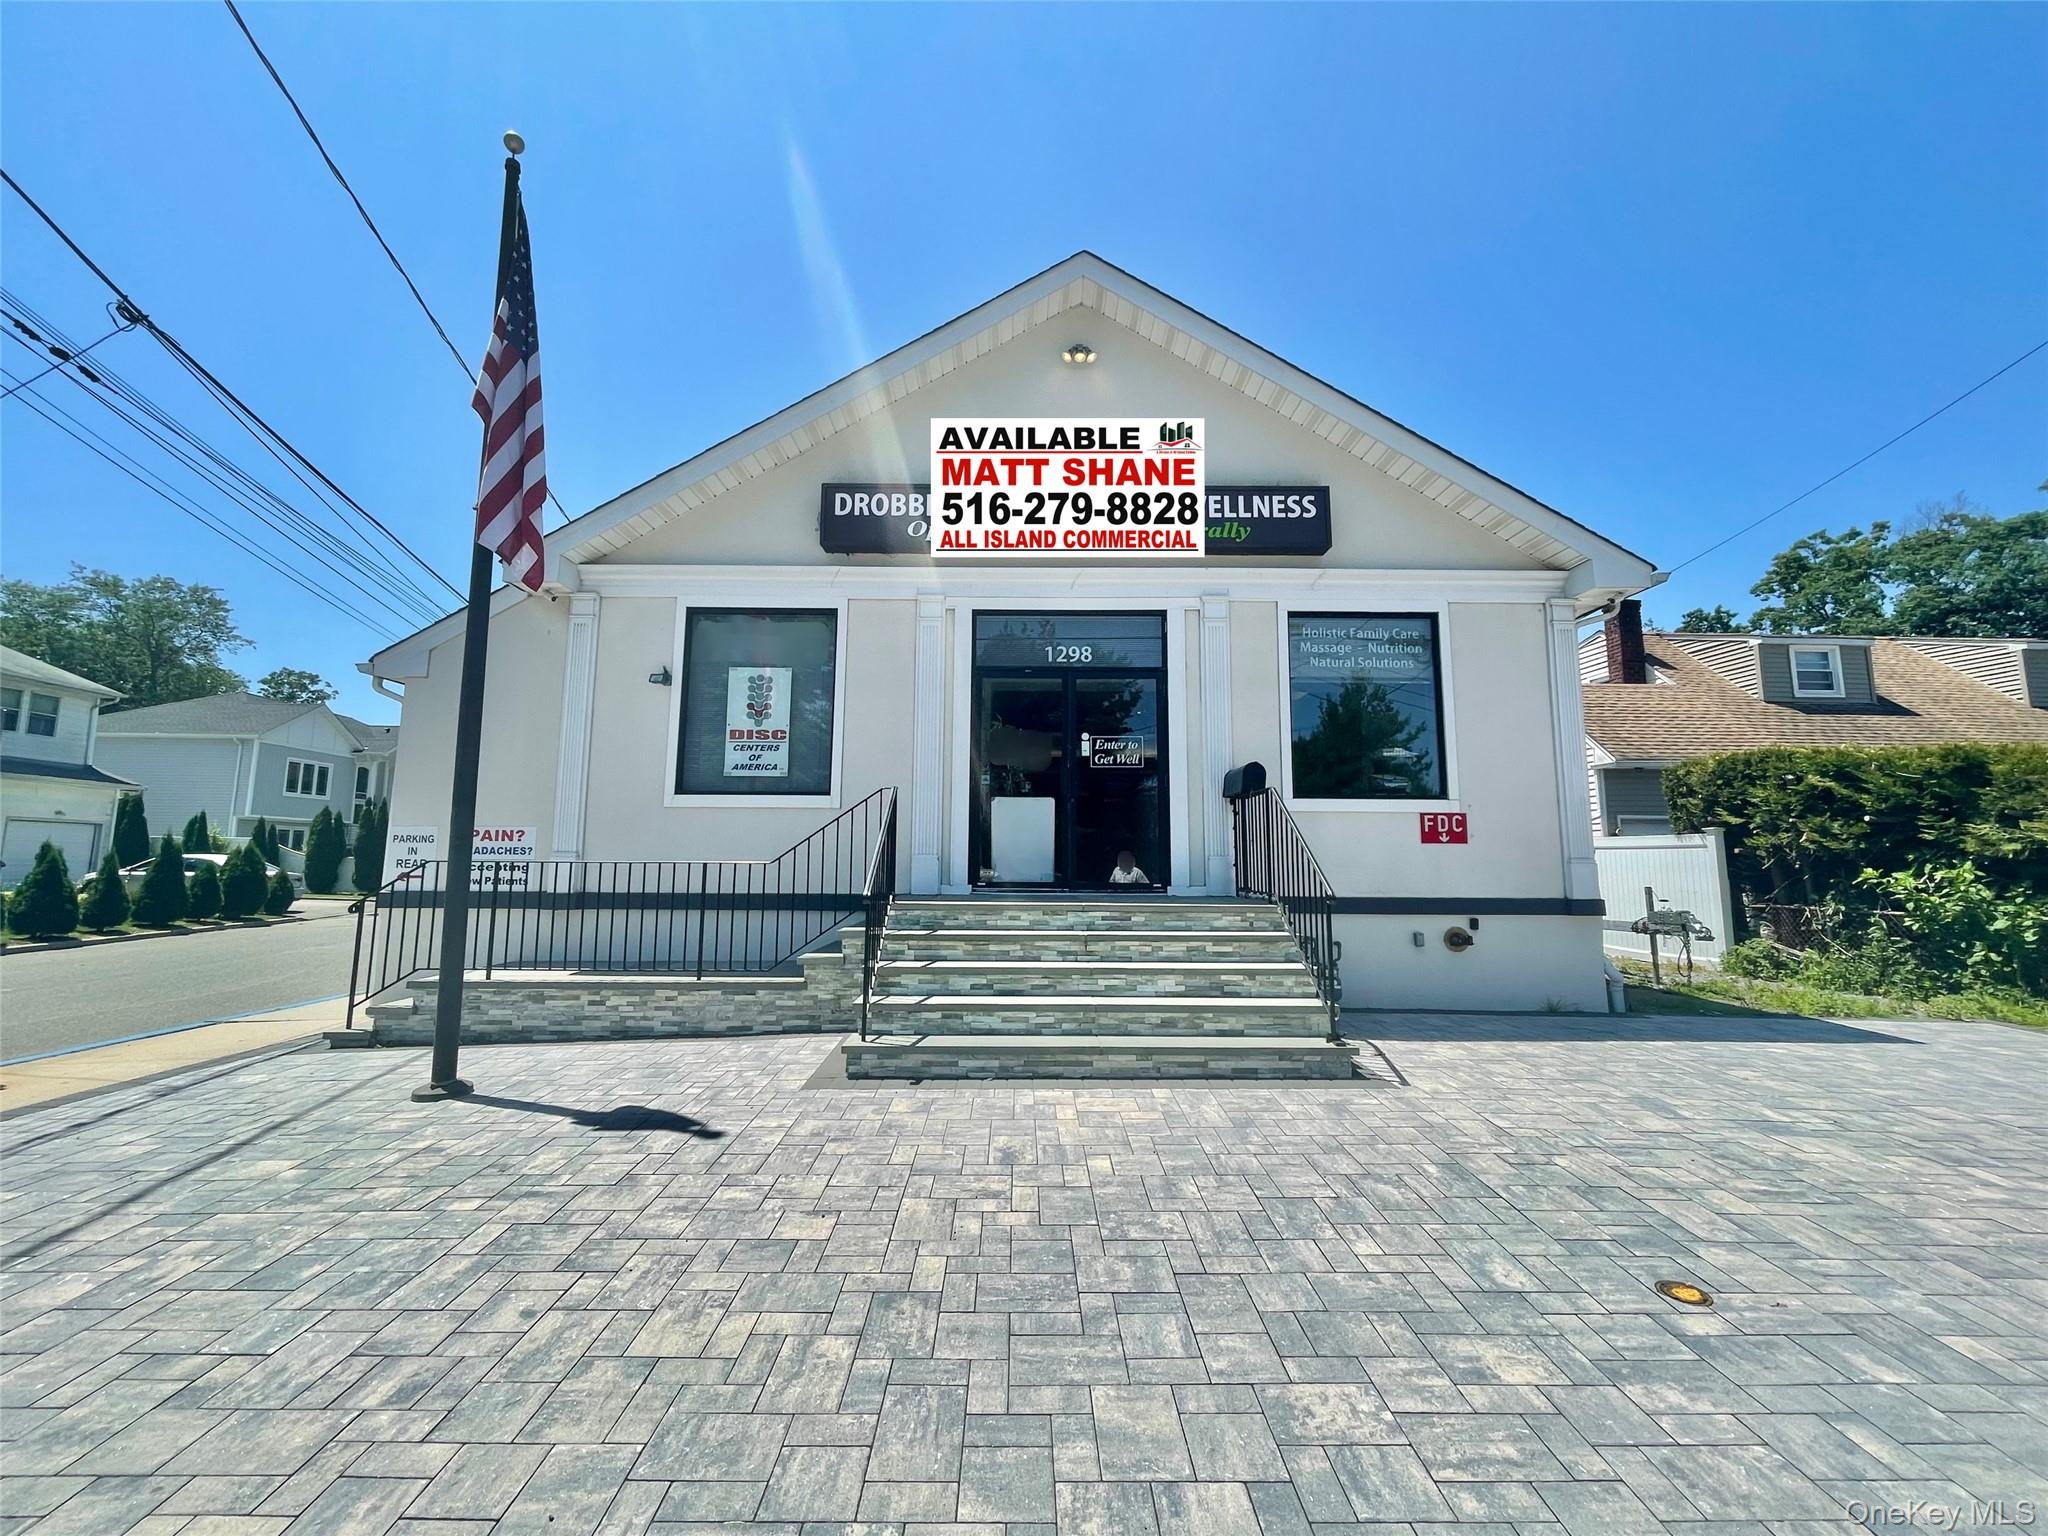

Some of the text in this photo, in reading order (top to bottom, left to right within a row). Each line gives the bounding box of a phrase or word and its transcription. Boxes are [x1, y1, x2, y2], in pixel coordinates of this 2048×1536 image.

[1205, 495, 1317, 518] ELLNESS
[1302, 627, 1419, 641] Holistic Family Care
[1045, 646, 1093, 663] 1298
[1300, 642, 1352, 656] Massage
[1368, 643, 1423, 654] Nutrition
[1310, 657, 1414, 669] Natural Solutions
[729, 729, 787, 740] DISC
[733, 744, 780, 752] CENTERS
[1095, 739, 1138, 750] Enter to
[748, 754, 763, 762] OF
[1095, 753, 1140, 765] Get Well
[731, 763, 778, 771] AMERICA
[1423, 815, 1463, 833] FDC
[393, 834, 435, 844] PARKING
[407, 846, 418, 856] IN
[473, 846, 533, 856] ADACHES?
